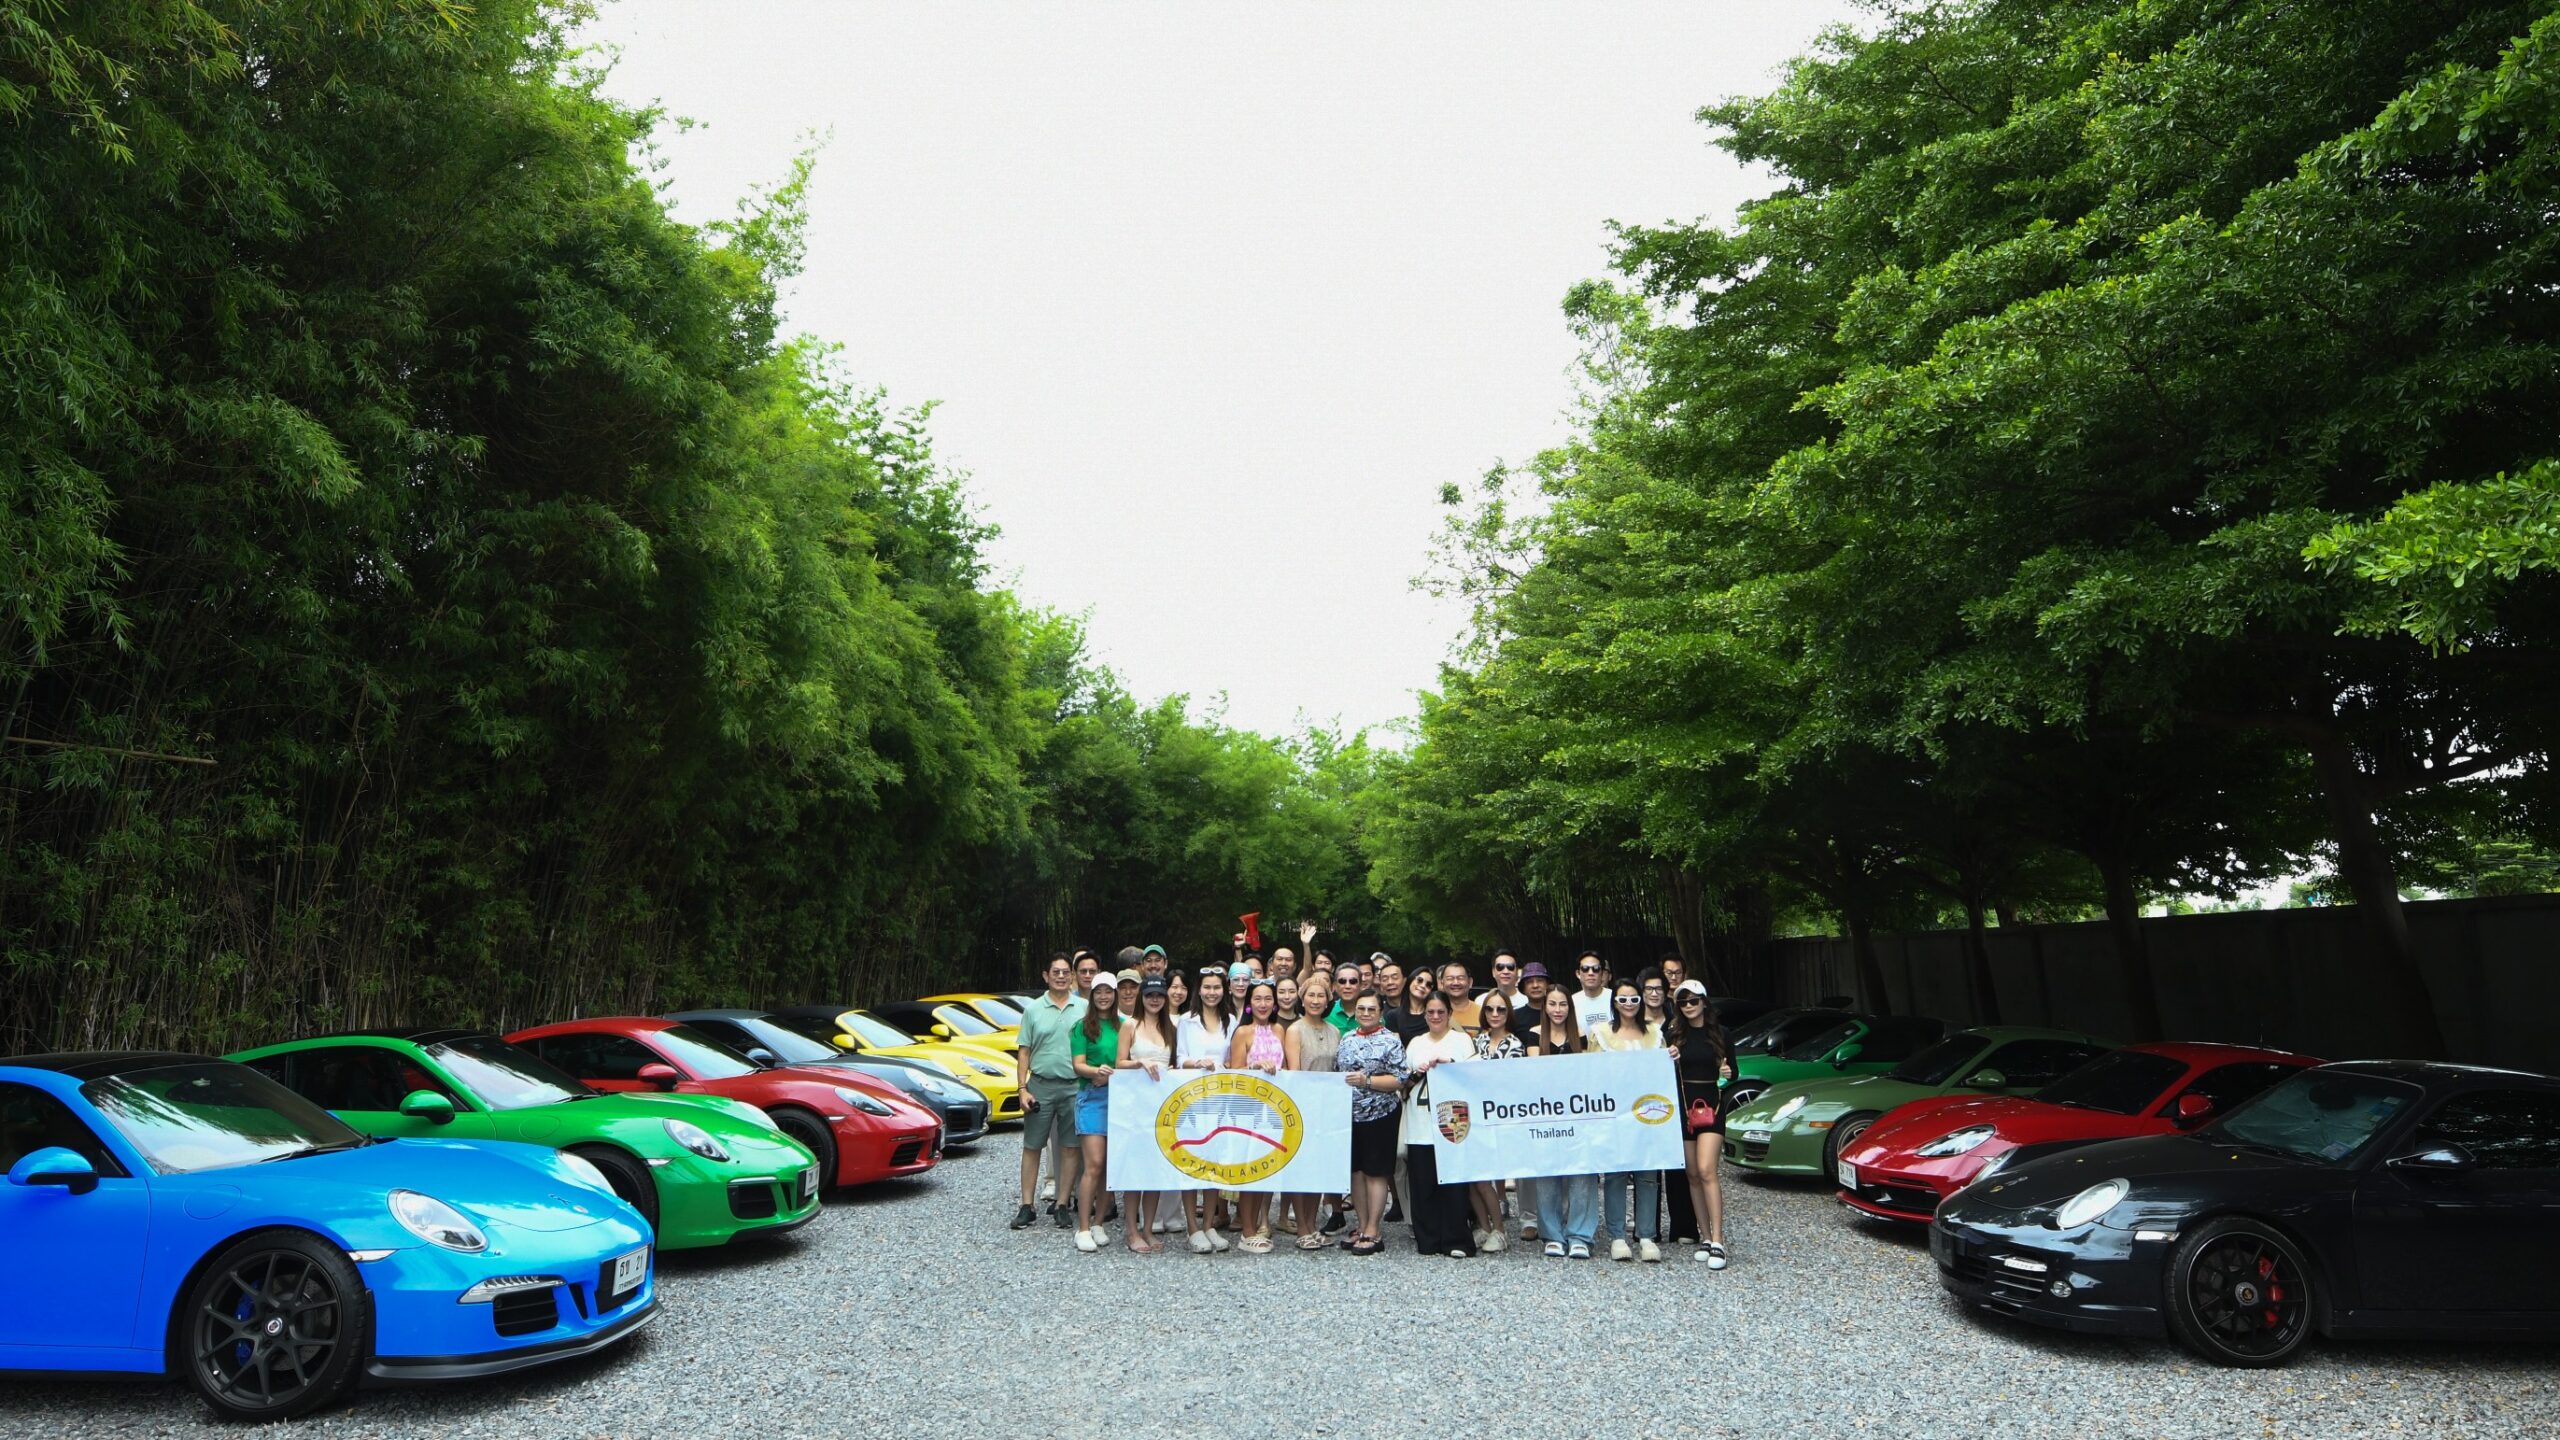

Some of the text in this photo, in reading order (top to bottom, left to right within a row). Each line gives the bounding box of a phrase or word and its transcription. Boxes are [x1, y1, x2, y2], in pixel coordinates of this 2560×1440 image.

[1162, 1079, 1296, 1128] PORSCHE CLUB
[1482, 1095, 1565, 1120] Porsche
[1569, 1092, 1616, 1114] Club
[1529, 1127, 1574, 1139] Thailand
[1189, 1159, 1270, 1178] THAILAND
[635, 1254, 643, 1270] 21
